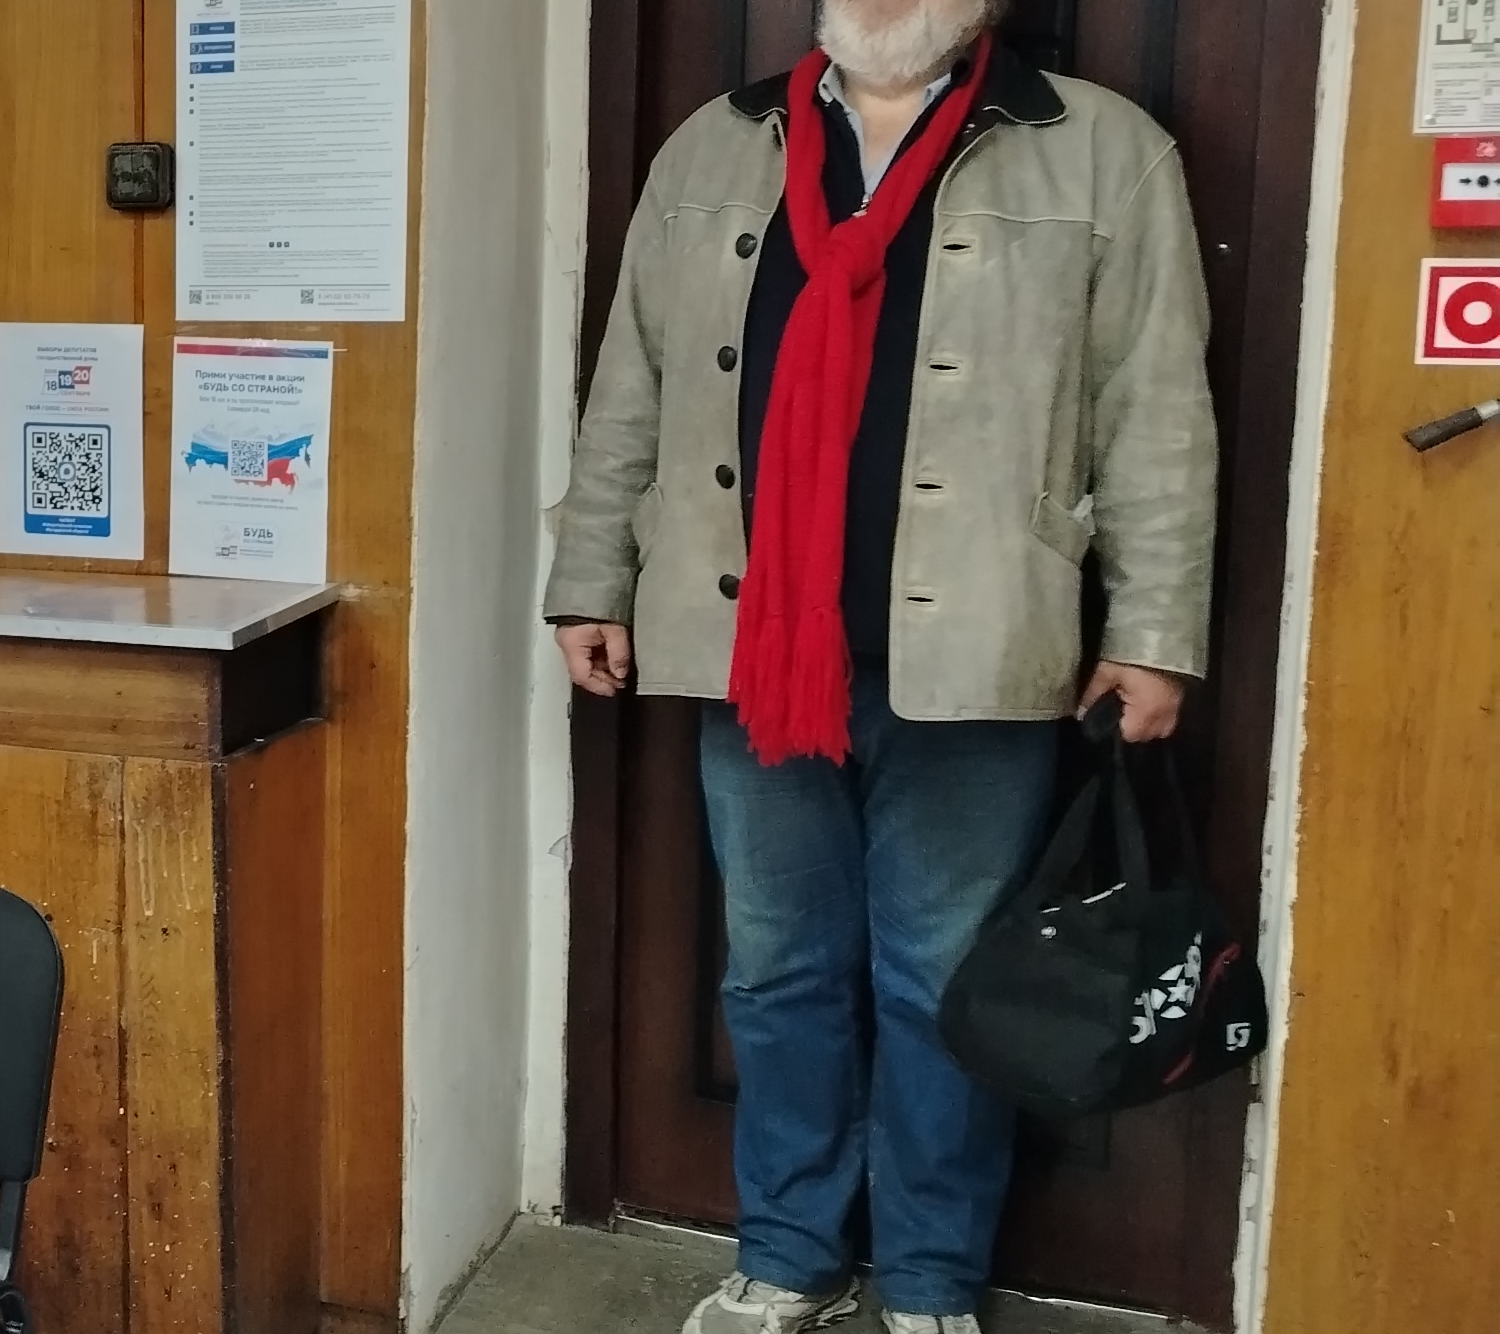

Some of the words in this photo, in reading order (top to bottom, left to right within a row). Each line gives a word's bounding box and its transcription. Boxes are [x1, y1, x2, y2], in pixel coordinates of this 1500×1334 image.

[45, 380, 58, 391] 18
[60, 374, 72, 386] 19
[73, 369, 89, 381] 20
[195, 369, 227, 380] Прими
[228, 372, 267, 382] участие
[275, 374, 306, 383] акции
[231, 383, 246, 393] СО
[243, 527, 274, 539] БУДЬ
